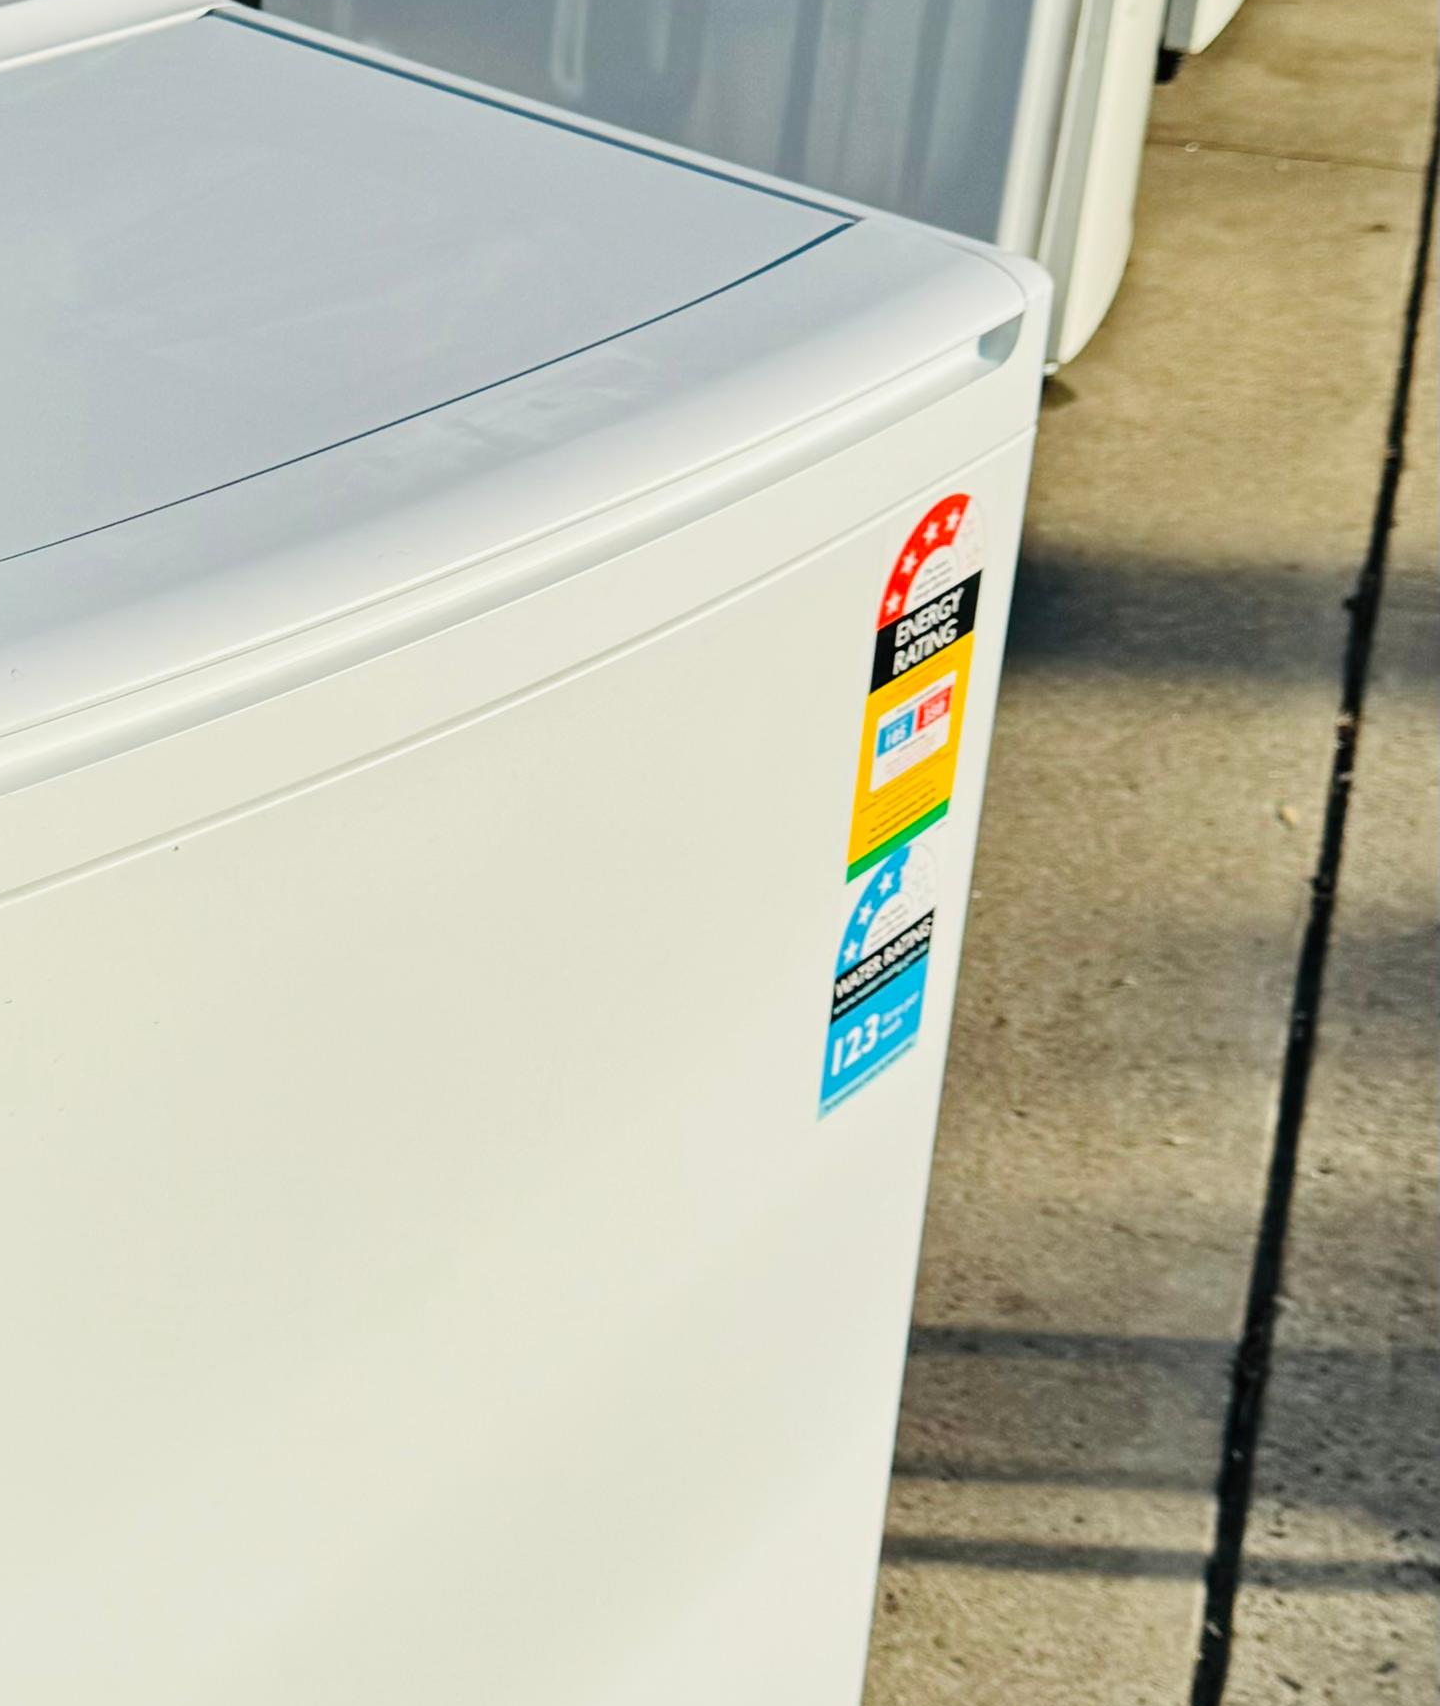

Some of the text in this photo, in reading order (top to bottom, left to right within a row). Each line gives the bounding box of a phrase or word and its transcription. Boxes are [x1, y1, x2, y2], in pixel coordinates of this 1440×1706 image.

[892, 618, 959, 675] RATING
[895, 587, 965, 648] ENERGY
[835, 954, 883, 999] WATER
[882, 916, 933, 967] RATING
[831, 1013, 881, 1077] 123
